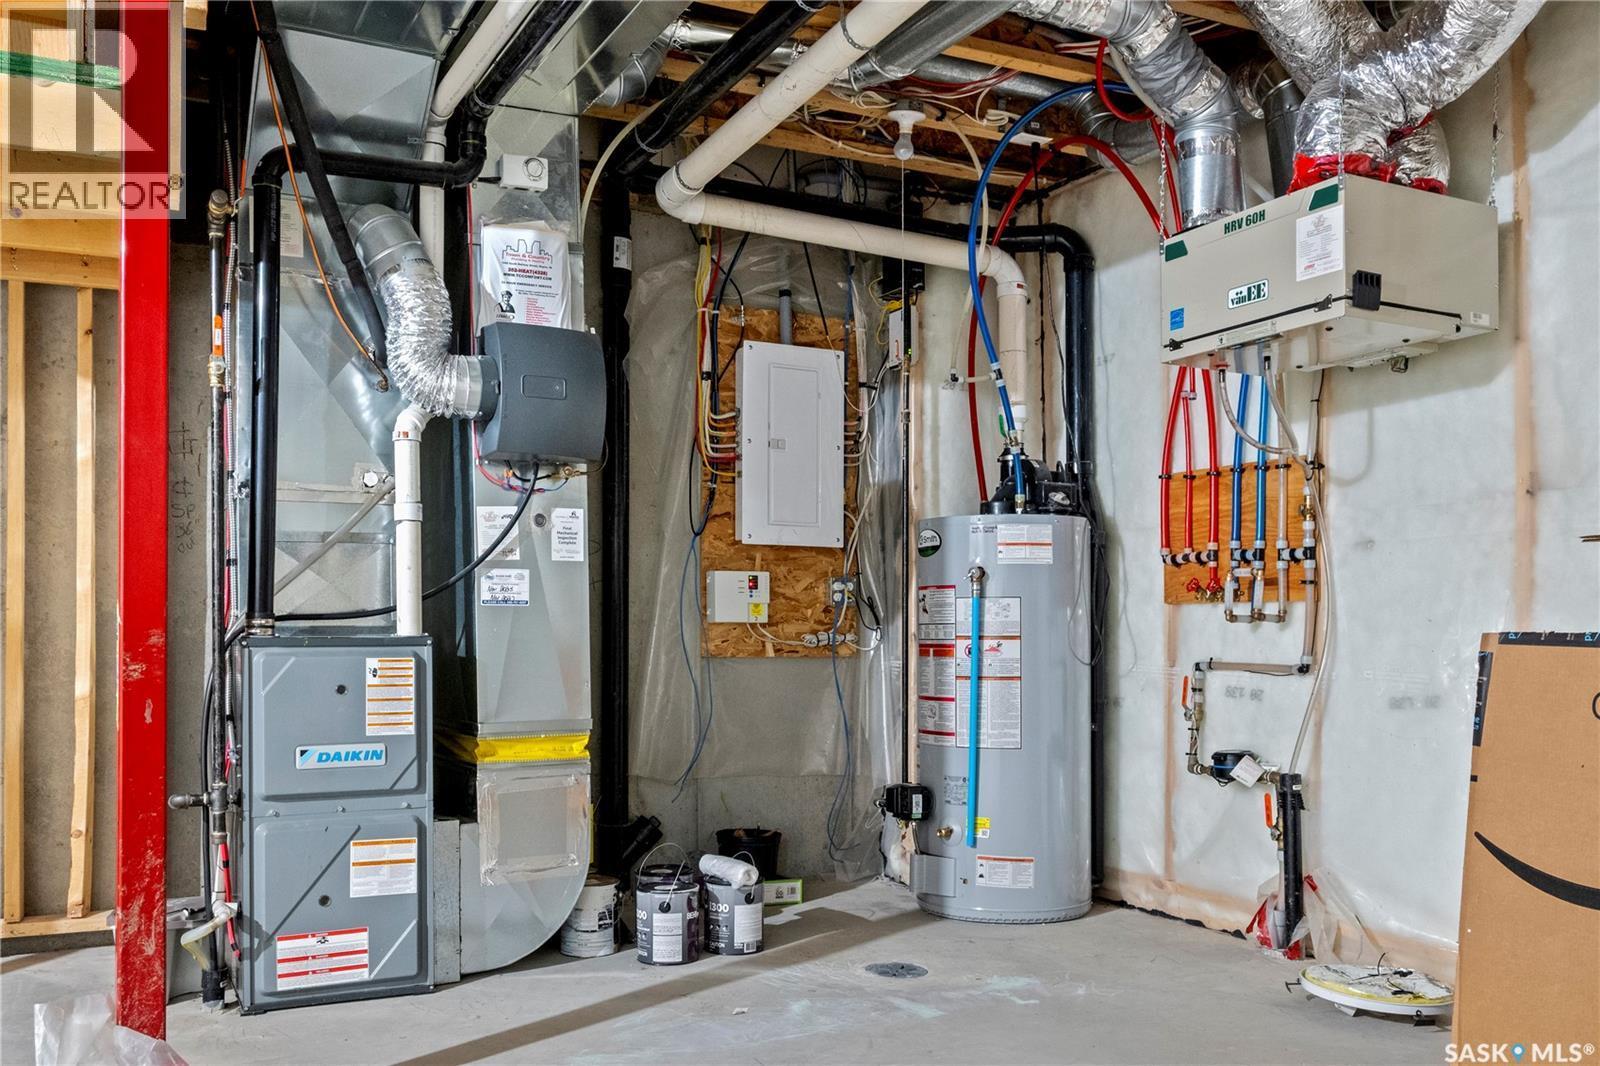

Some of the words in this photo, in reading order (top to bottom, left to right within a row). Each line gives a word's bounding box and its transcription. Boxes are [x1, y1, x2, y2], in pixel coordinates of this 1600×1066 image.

[1224, 218, 1244, 234] HRV
[1245, 209, 1266, 227] 60H
[316, 749, 384, 763] DAIKIN
